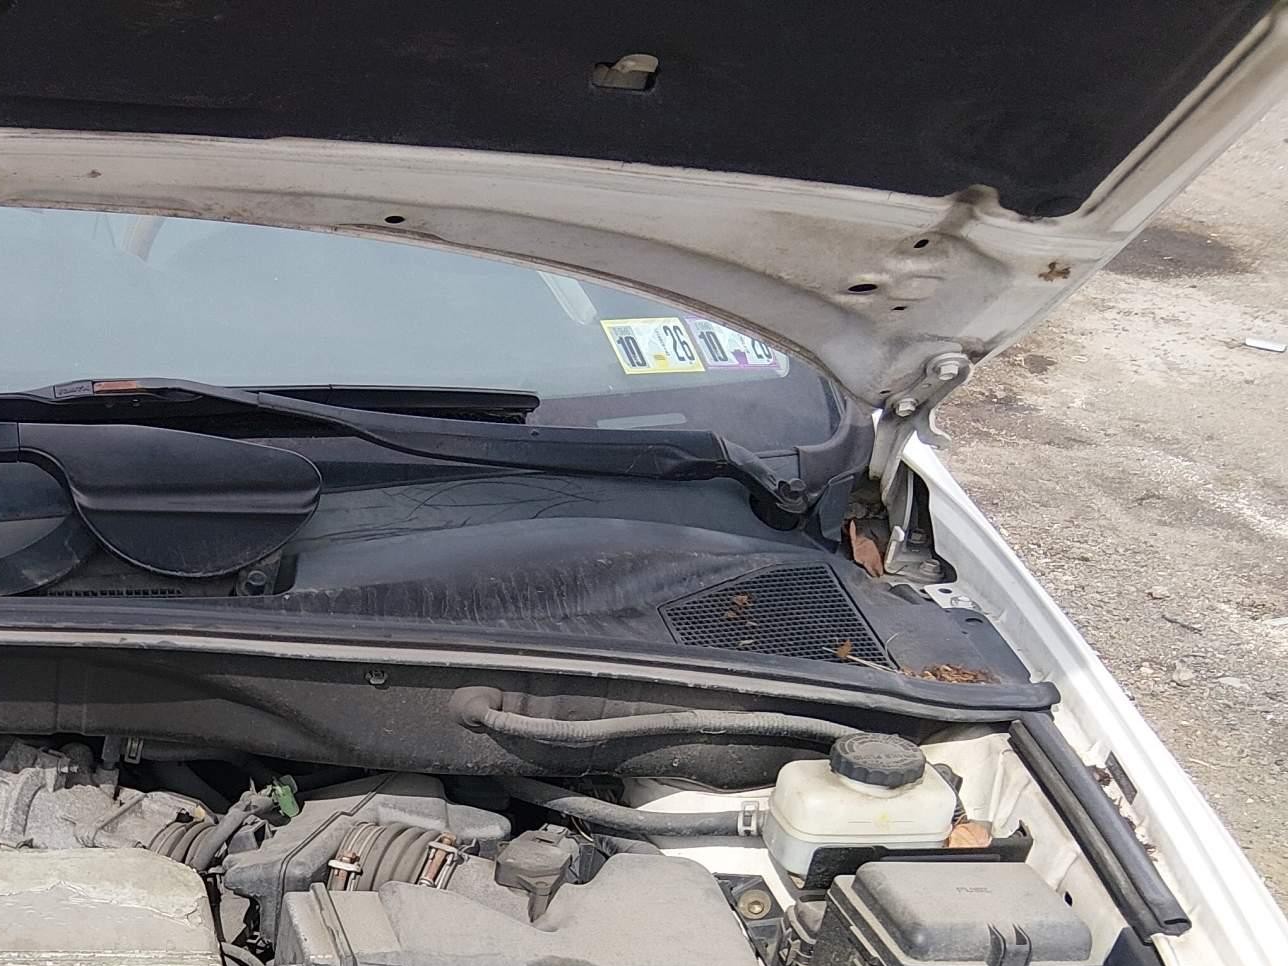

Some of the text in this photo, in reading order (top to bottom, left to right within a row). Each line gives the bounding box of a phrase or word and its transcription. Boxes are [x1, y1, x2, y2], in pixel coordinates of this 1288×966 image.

[617, 335, 647, 367] 10
[663, 325, 695, 362] 26
[698, 331, 728, 362] 10
